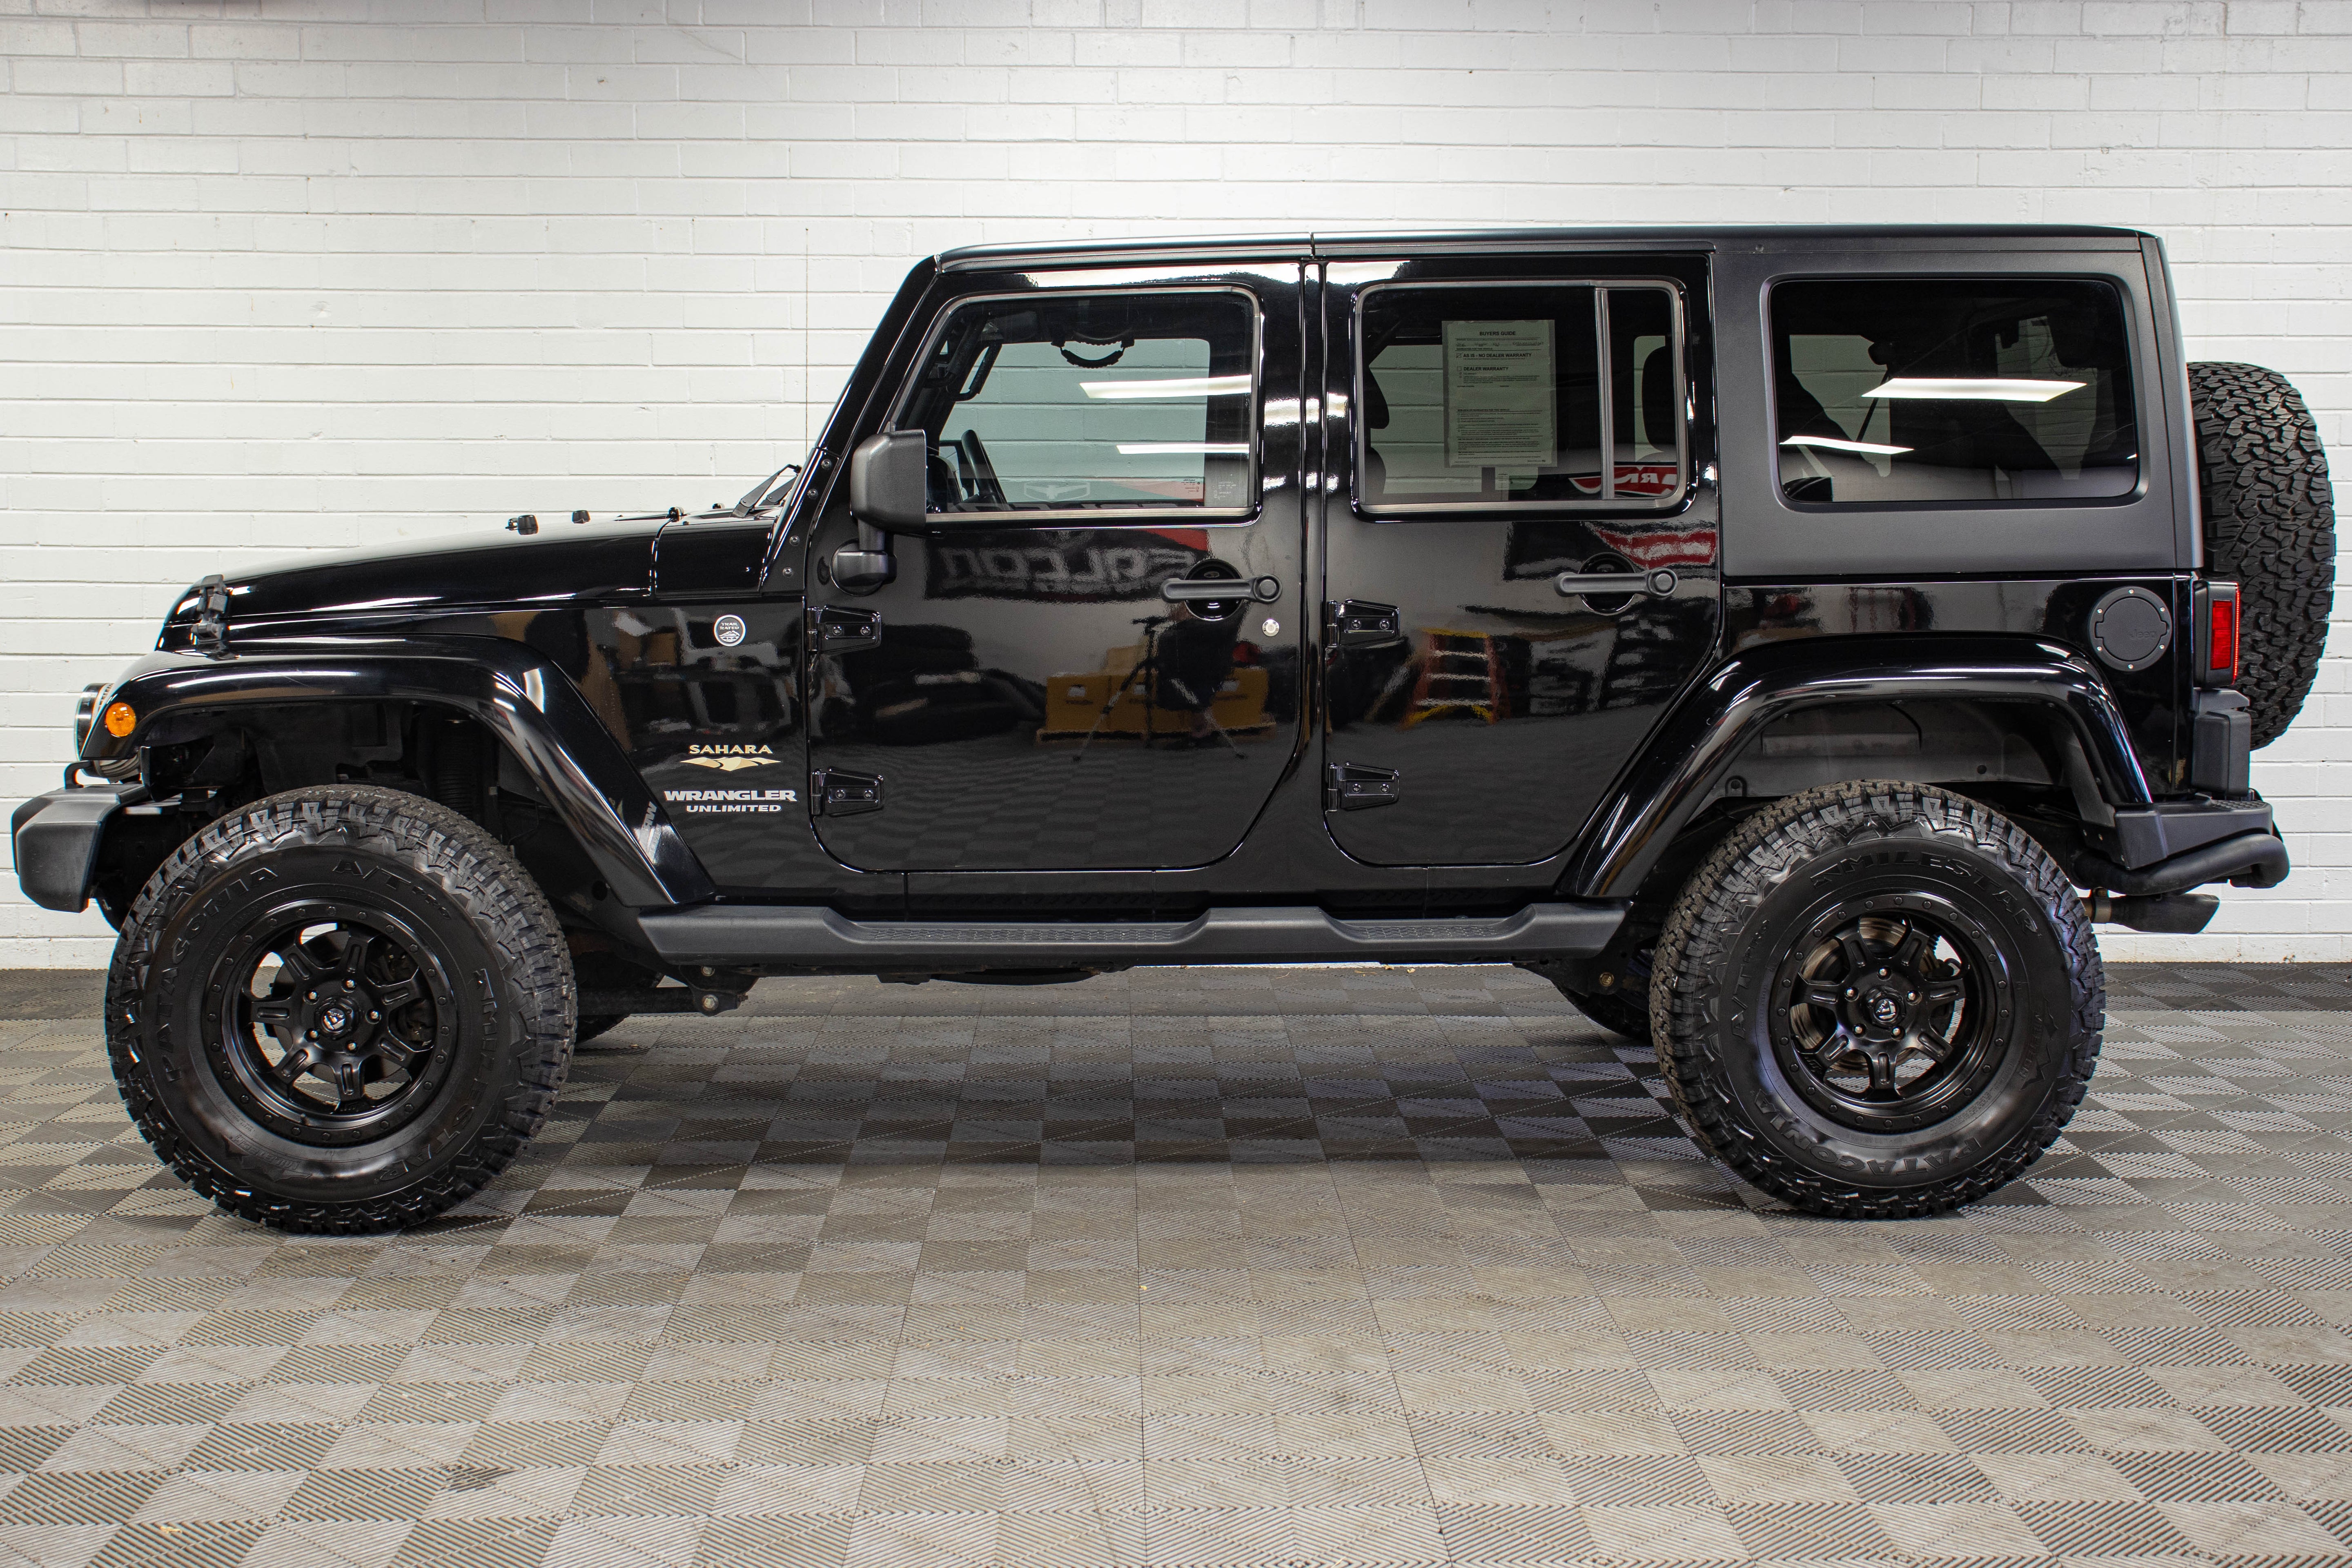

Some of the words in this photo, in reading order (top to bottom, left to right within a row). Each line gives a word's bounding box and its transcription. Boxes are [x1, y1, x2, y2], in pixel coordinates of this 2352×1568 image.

[689, 744, 774, 754] SAHARA
[664, 790, 797, 802] WRANGLER
[686, 804, 782, 813] UNLIMITED
[1840, 851, 2039, 935] MILESTAR
[155, 866, 279, 1082] PATAGONIA
[379, 1001, 498, 1181] MILESTAR
[1753, 1089, 1983, 1177] PATAGONIA
